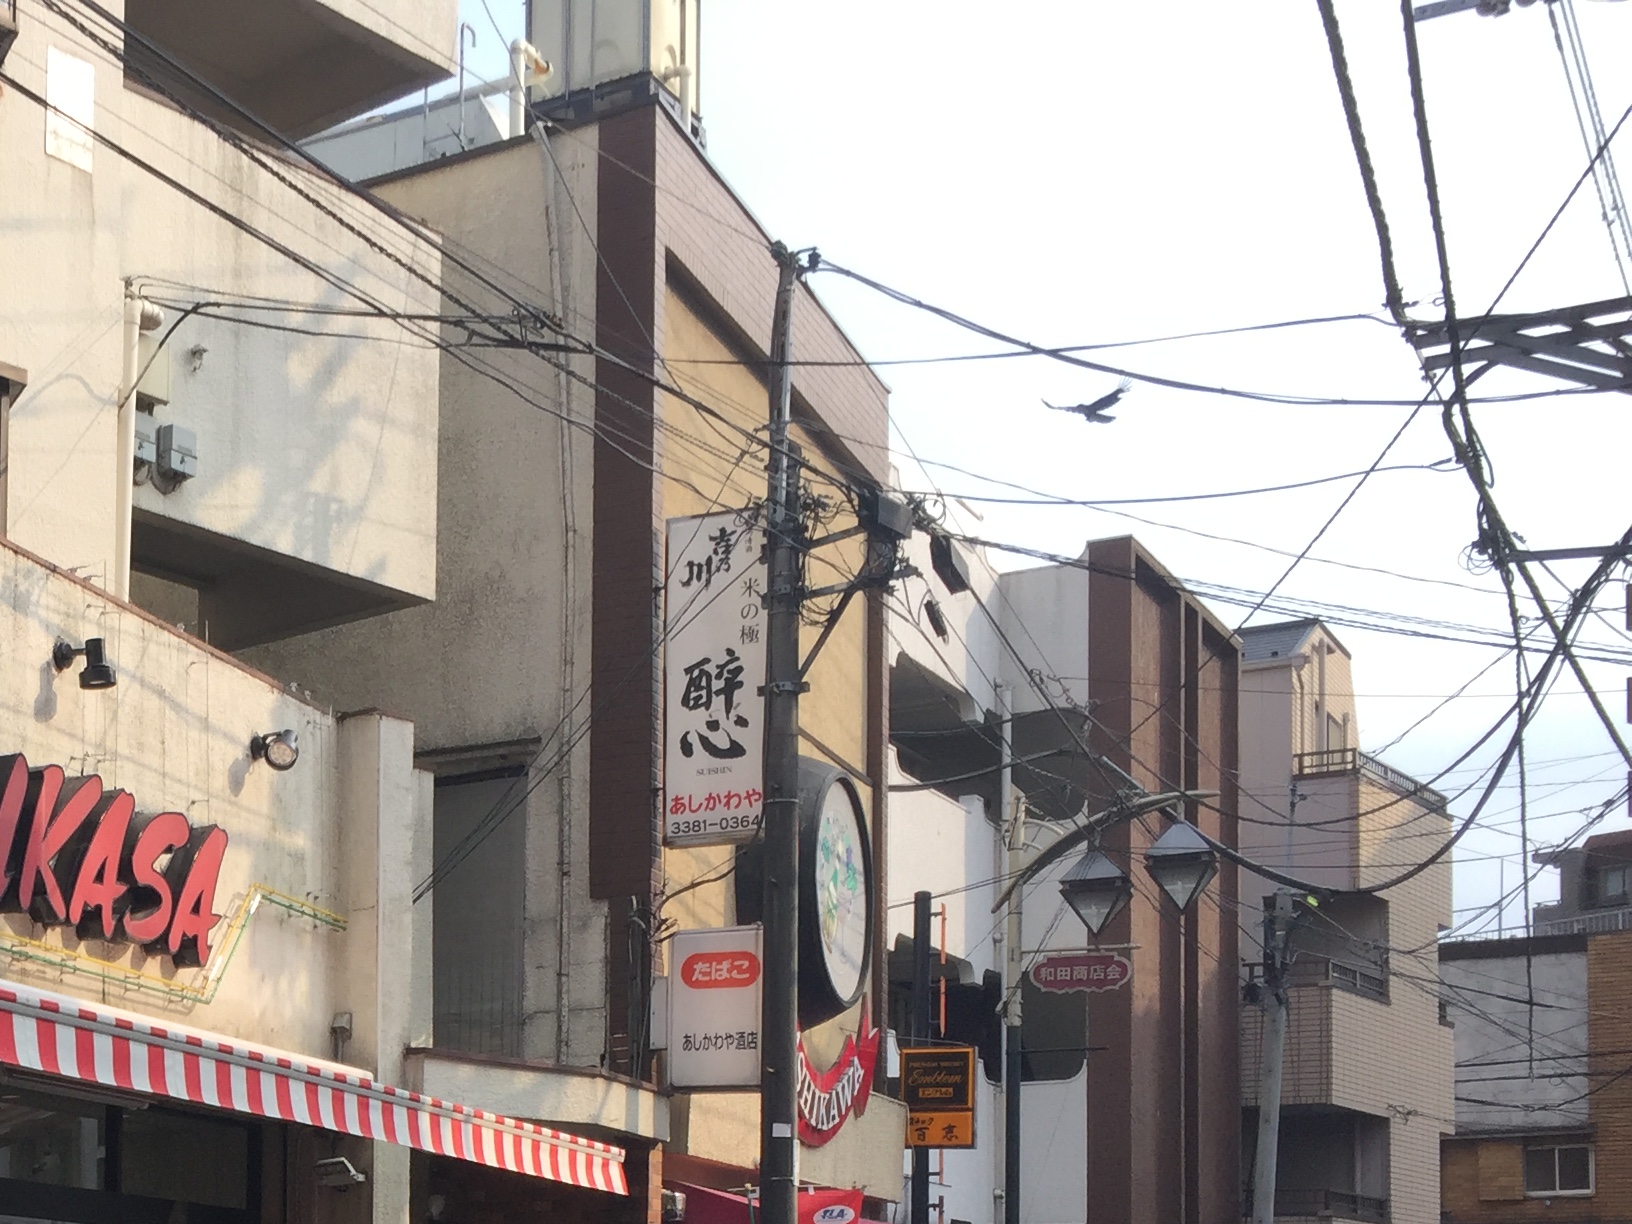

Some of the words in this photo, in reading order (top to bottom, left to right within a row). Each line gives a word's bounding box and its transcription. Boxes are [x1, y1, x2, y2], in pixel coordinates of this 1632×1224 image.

[739, 577, 760, 645] 米の極
[669, 788, 763, 816] あしかわや
[670, 813, 761, 835] 3381-0364
[691, 959, 750, 982] たばこ
[1039, 964, 1122, 981] 和田商店会
[682, 1031, 758, 1052] あしかわや酒店
[797, 1051, 865, 1131] SHIKAWA
